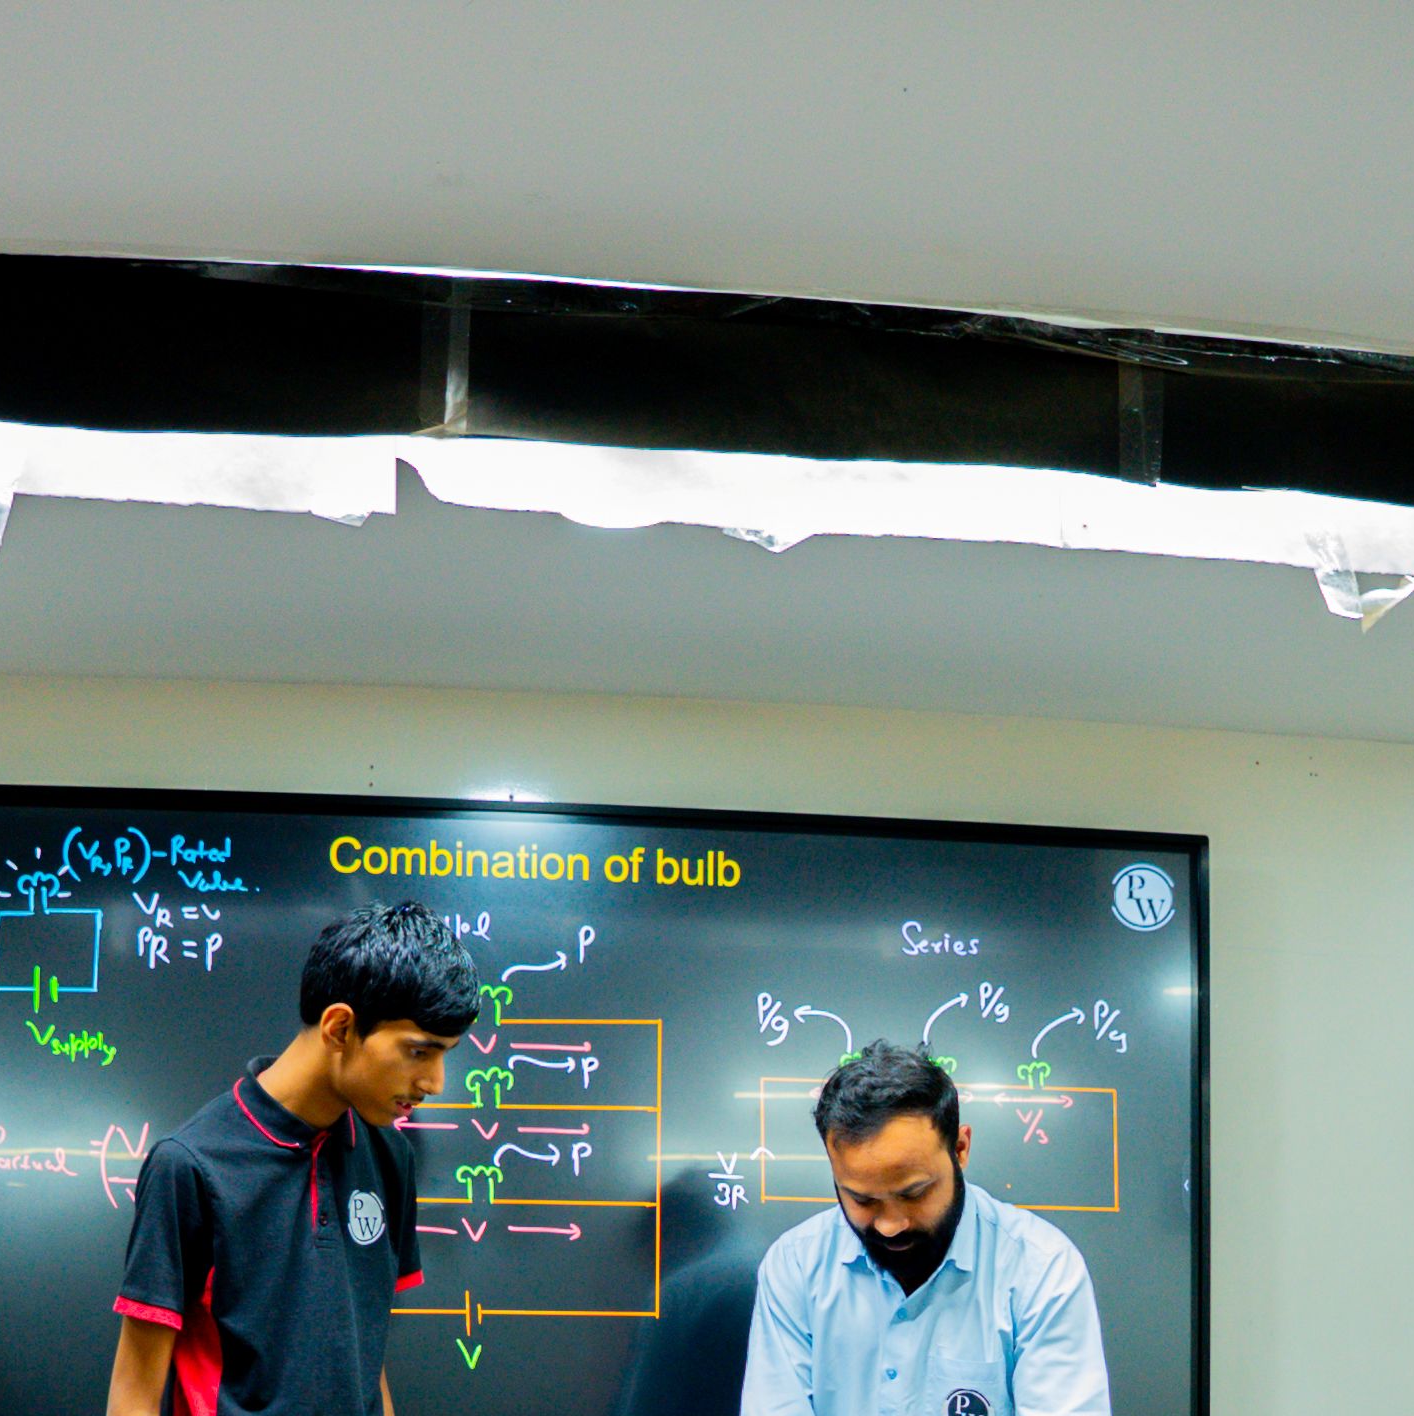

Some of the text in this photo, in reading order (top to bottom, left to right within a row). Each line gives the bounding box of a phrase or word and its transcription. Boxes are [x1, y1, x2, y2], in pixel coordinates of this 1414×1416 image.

[329, 835, 742, 888] Combination of bulb
[901, 921, 980, 957] Series
